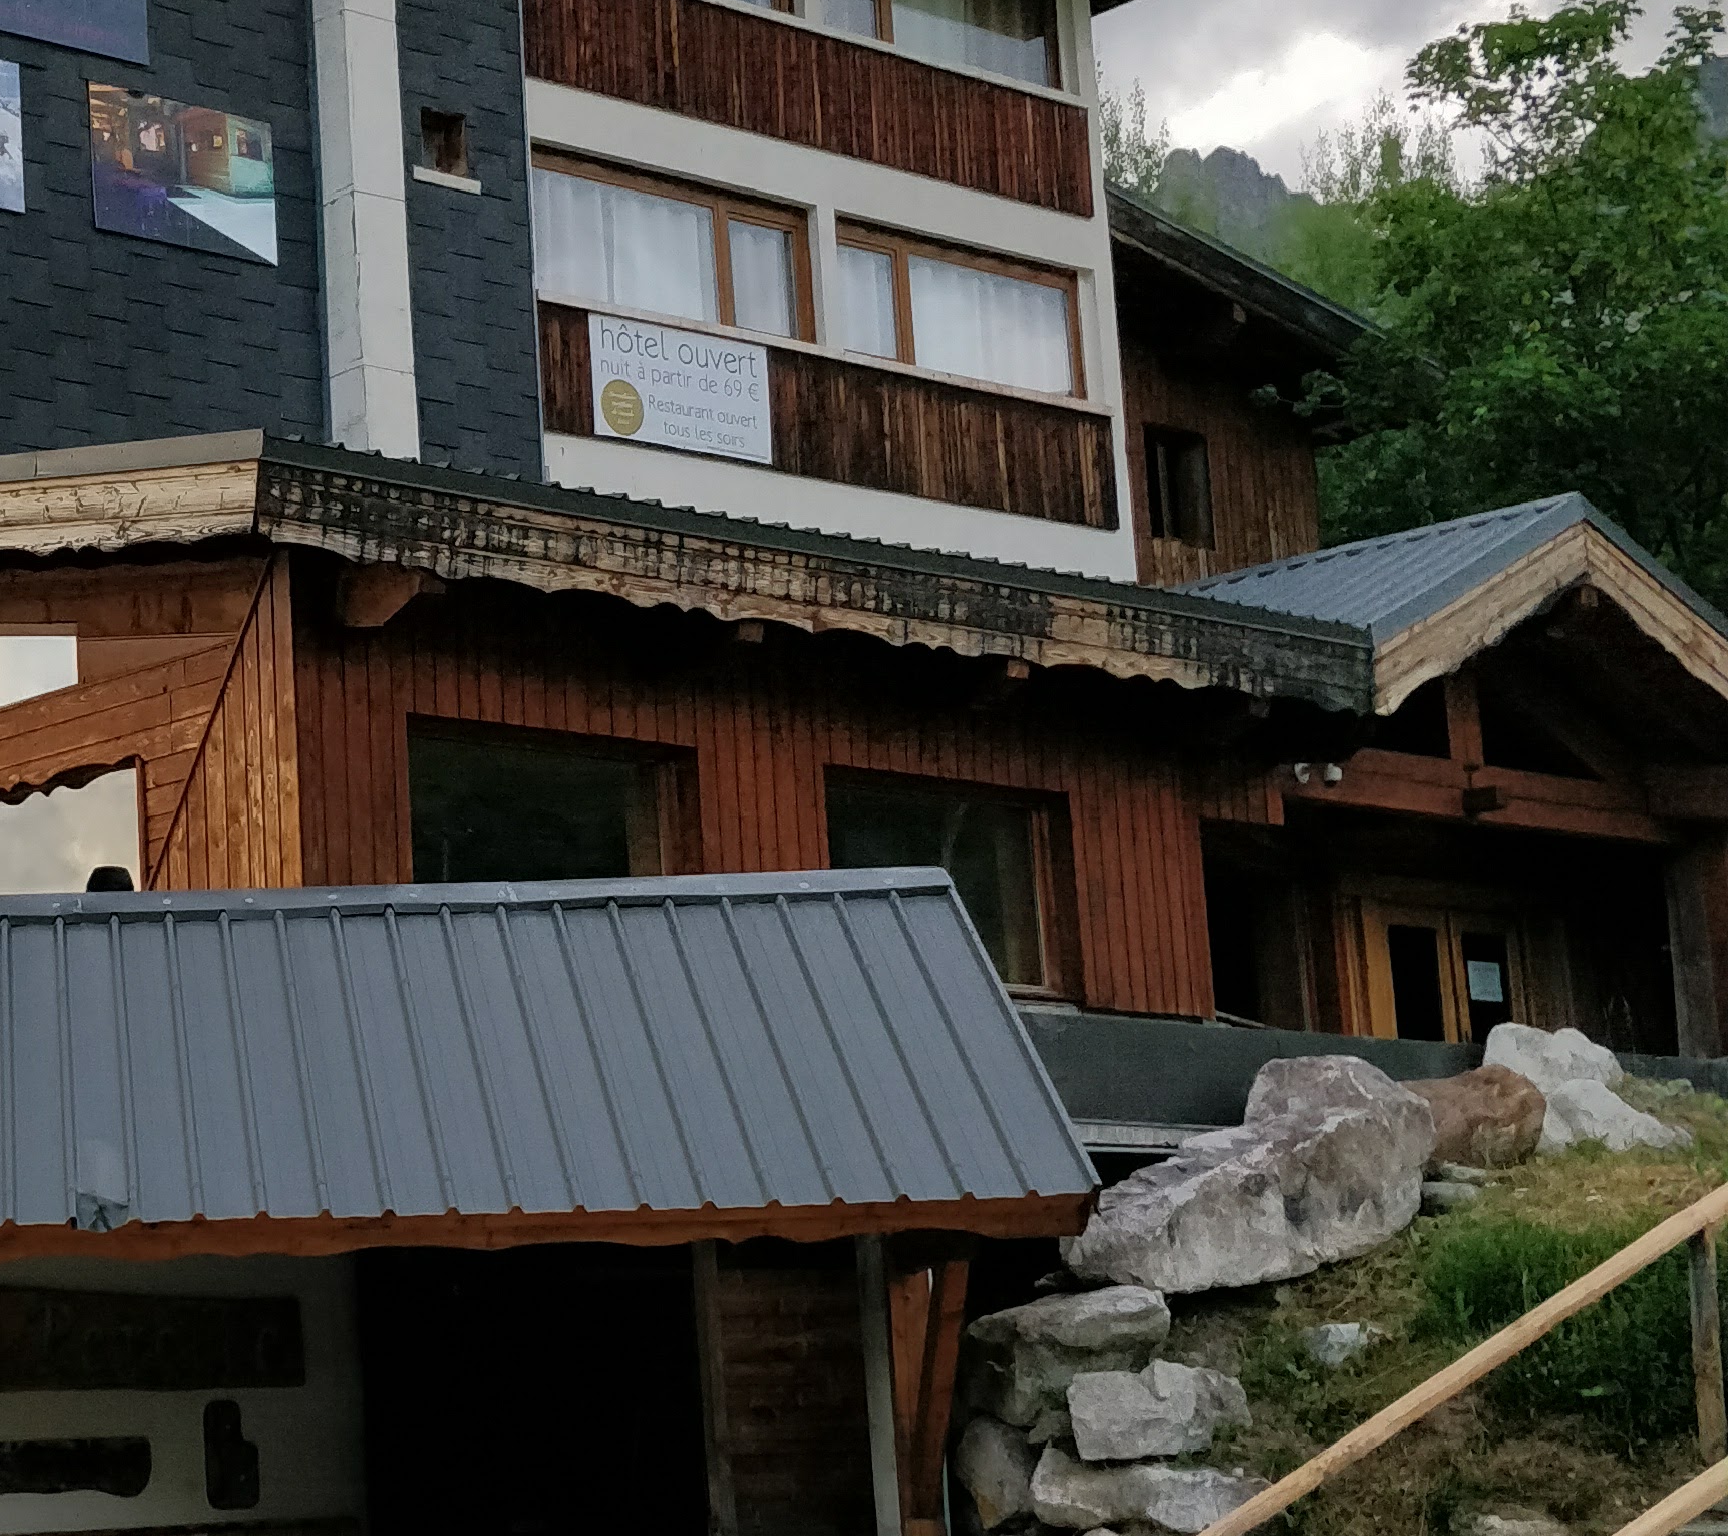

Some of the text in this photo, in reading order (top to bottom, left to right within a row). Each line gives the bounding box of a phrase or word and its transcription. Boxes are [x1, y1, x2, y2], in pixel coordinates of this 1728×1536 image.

[600, 318, 758, 378] hôtel ouvert
[600, 358, 761, 403] nuit à partir de 69 €
[647, 394, 715, 421] Restaurant
[717, 410, 759, 430] ouvert
[663, 420, 746, 448] tous les soirs
